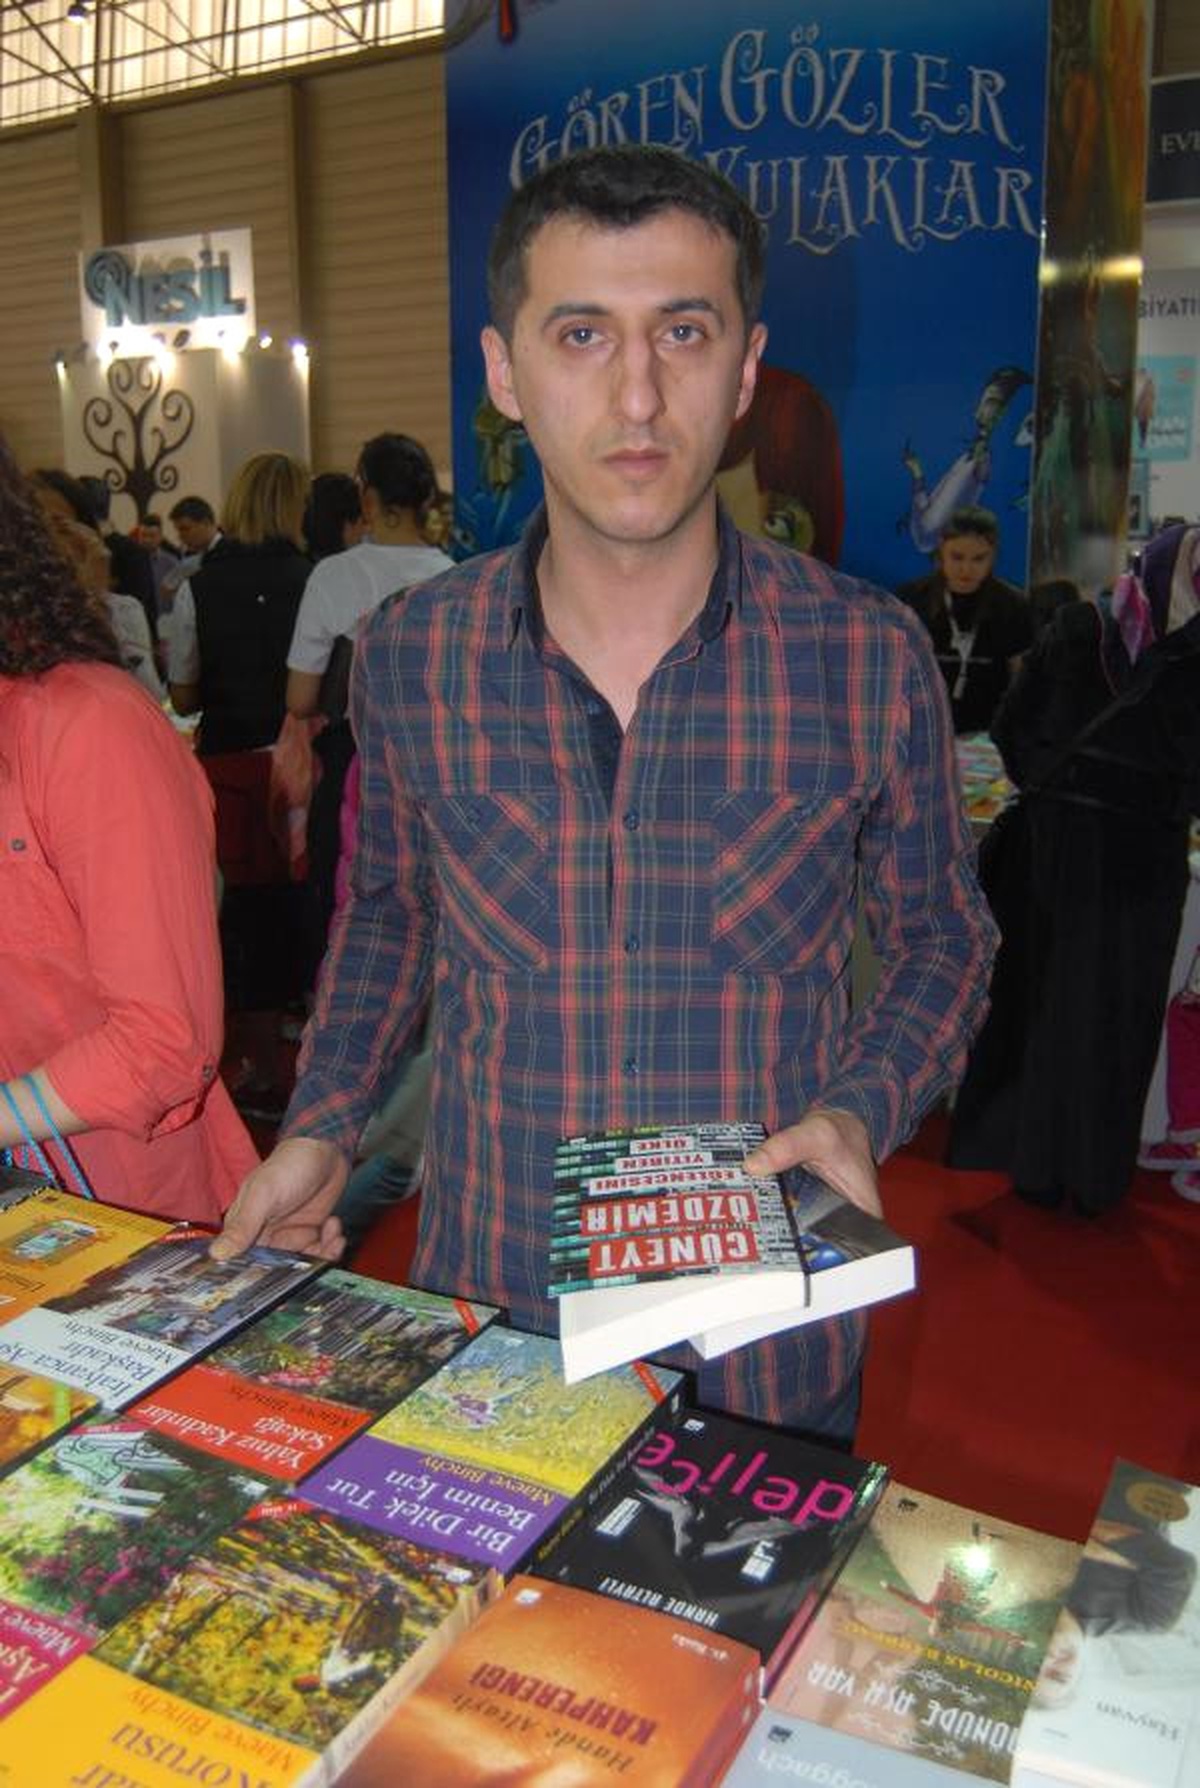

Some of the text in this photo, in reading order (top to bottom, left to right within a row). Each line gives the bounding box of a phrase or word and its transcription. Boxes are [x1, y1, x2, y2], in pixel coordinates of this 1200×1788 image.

[719, 22, 1025, 154] GÖZLER
[586, 1194, 752, 1234] ÖZDEMİR
[594, 1231, 750, 1273] CÜNEYT
[325, 1477, 377, 1511] Tut
[419, 1454, 556, 1508] Maeve Binchy
[637, 1433, 855, 1526] delice
[384, 1496, 465, 1537] Dilek
[444, 1487, 537, 1532] Benim
[464, 1522, 516, 1555] Bir
[662, 1596, 718, 1629] HANDE
